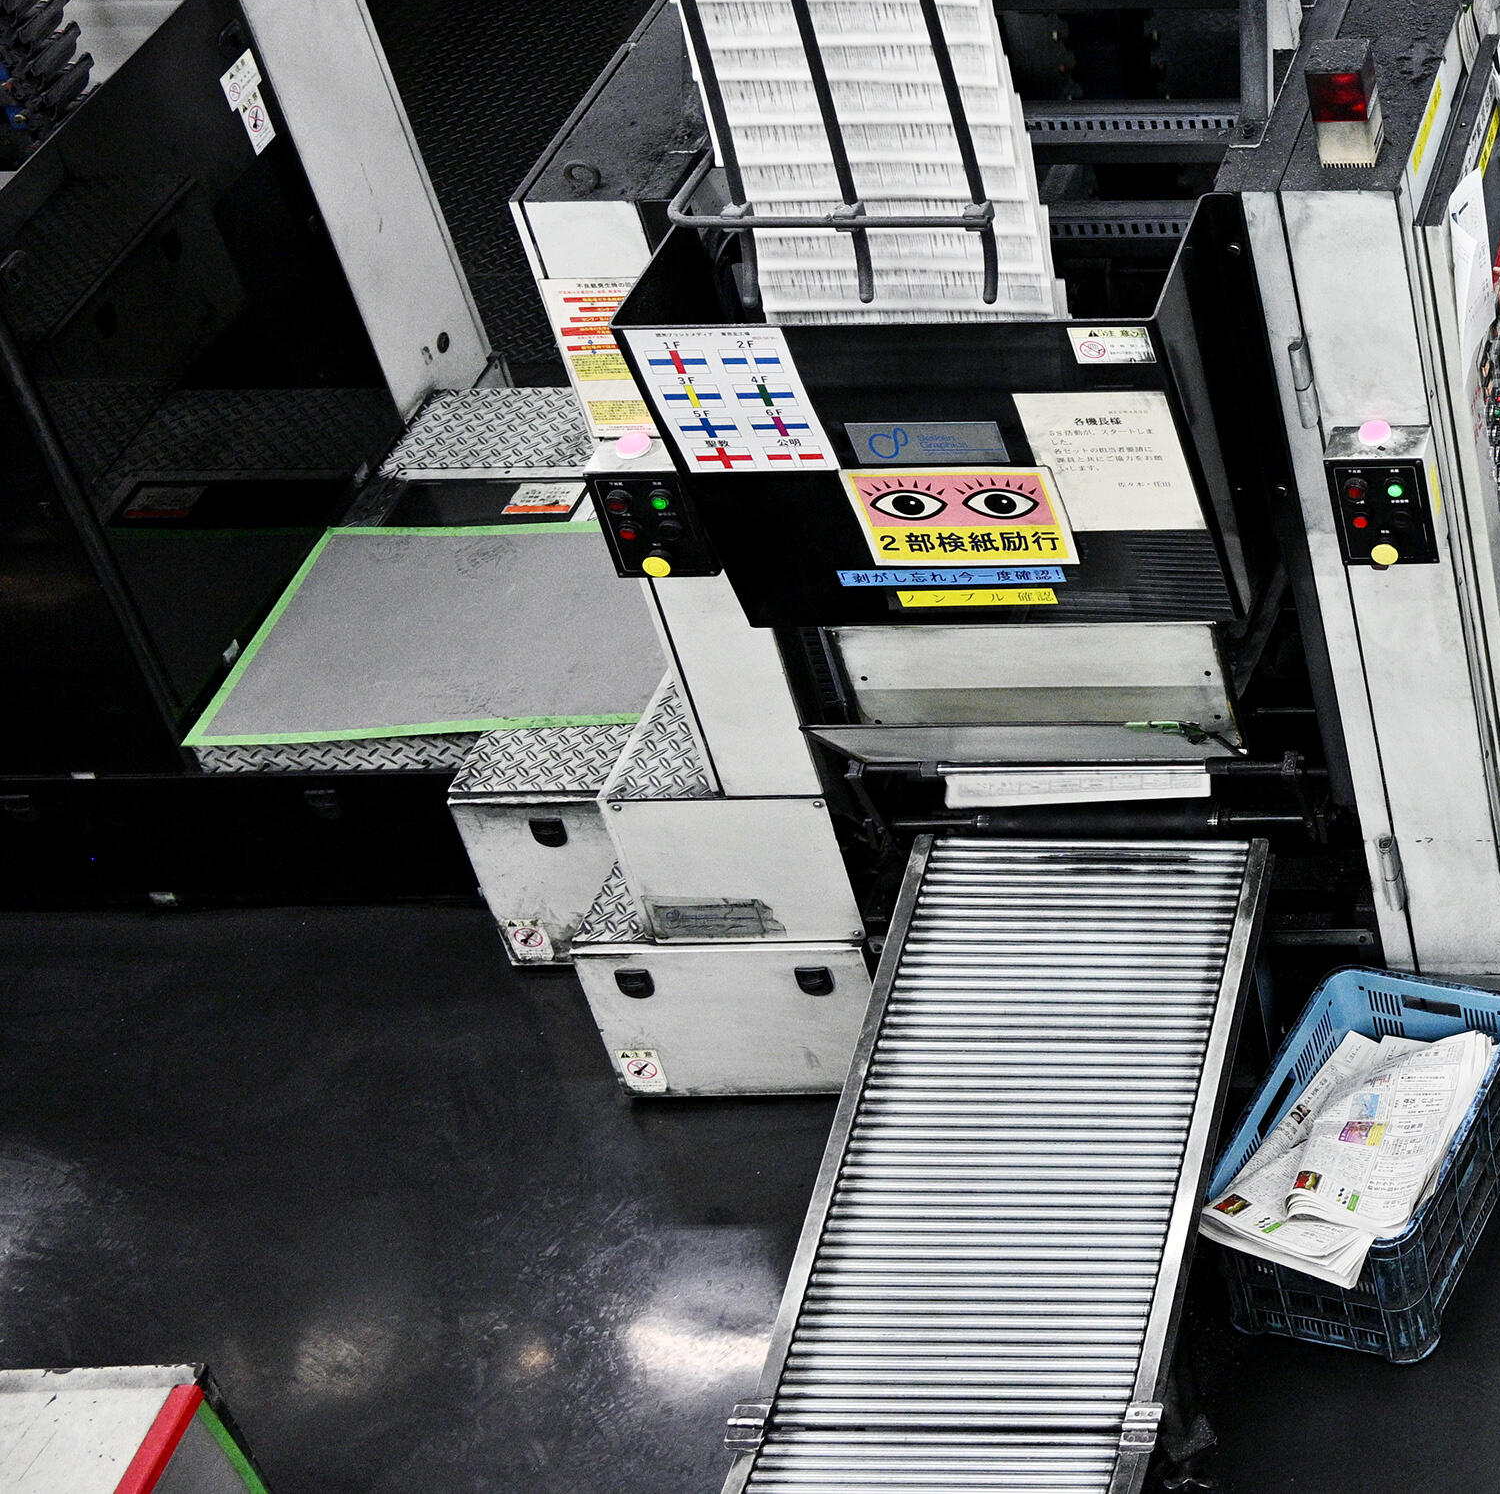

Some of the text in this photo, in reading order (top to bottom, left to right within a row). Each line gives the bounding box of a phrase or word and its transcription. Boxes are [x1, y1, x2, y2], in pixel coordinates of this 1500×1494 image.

[1073, 417, 1123, 426] 各機長様
[705, 438, 802, 448] 聖教 公明
[879, 531, 1060, 553] 2部検紙励行
